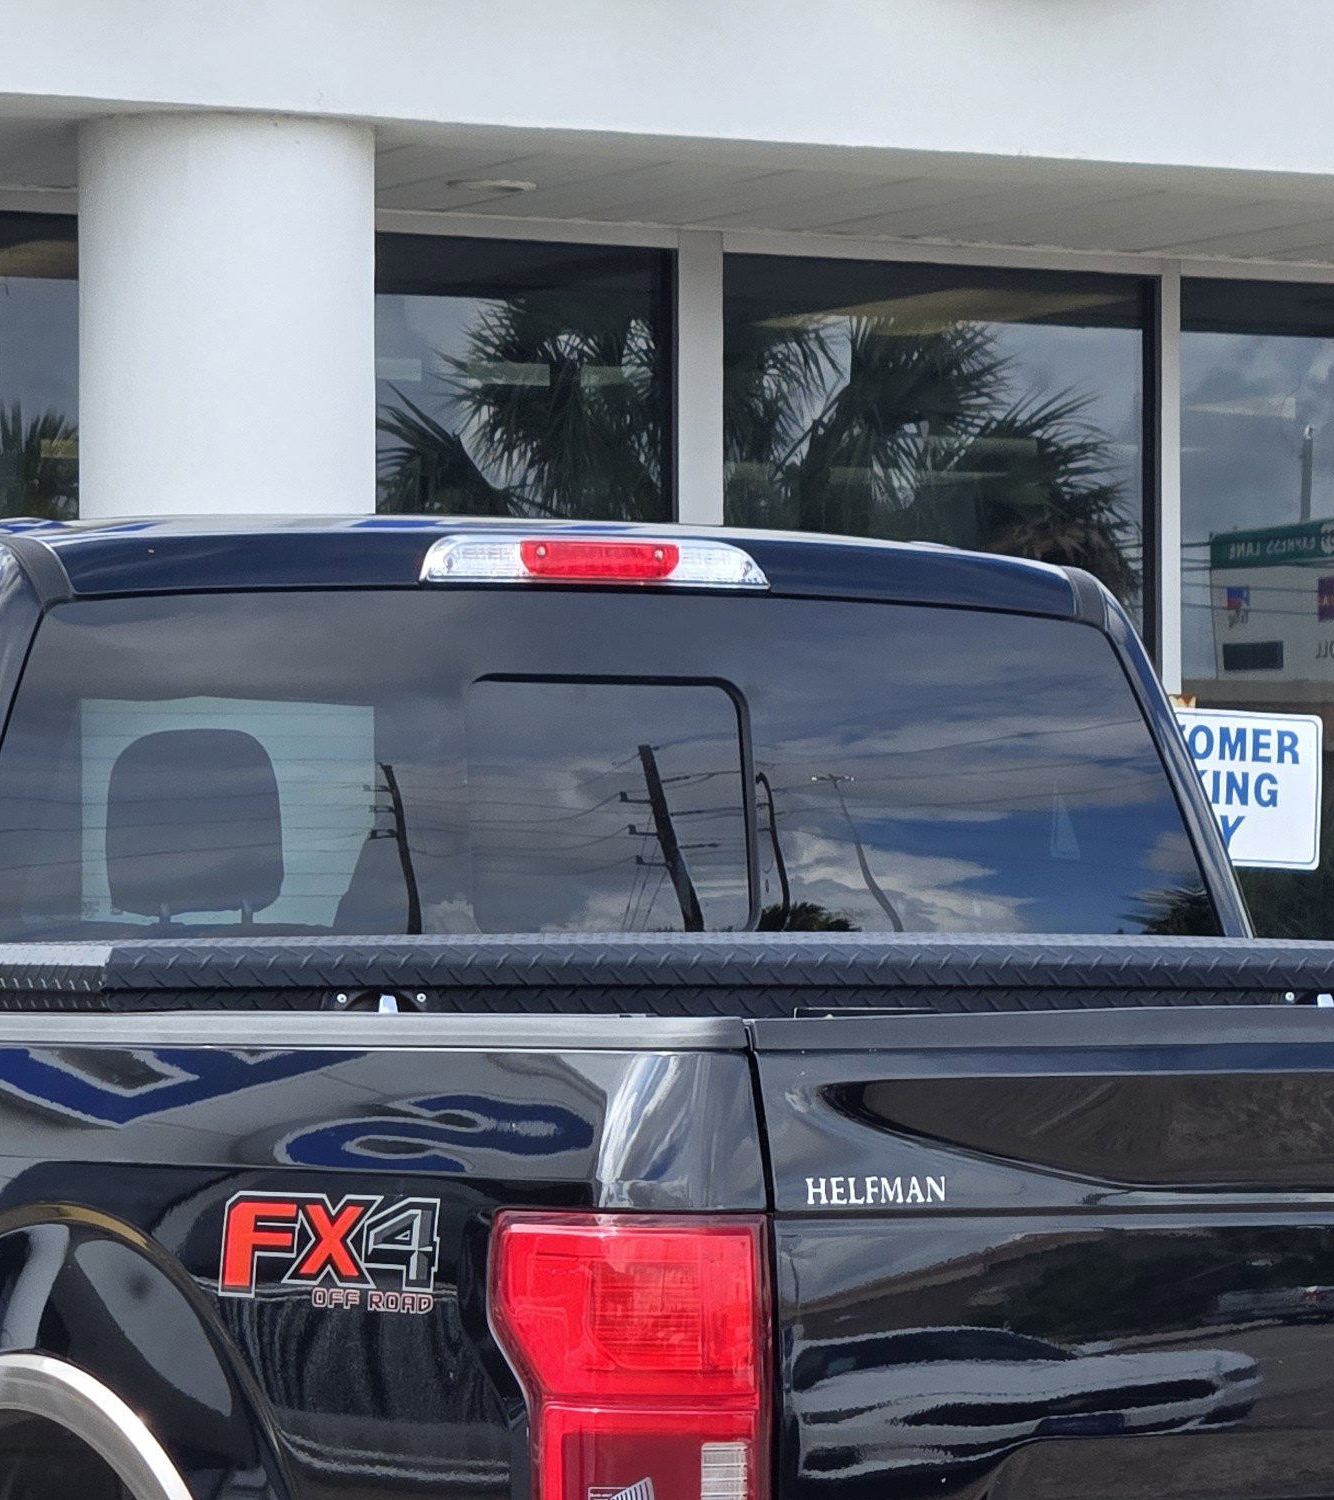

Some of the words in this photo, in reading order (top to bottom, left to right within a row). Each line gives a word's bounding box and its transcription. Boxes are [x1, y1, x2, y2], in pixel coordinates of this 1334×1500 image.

[1180, 724, 1300, 765] OMER
[1199, 769, 1278, 808] ING
[805, 1175, 946, 1205] HELFMAN
[218, 1190, 441, 1298] FX4
[312, 1287, 360, 1310] OFF
[367, 1289, 434, 1315] ROAD
